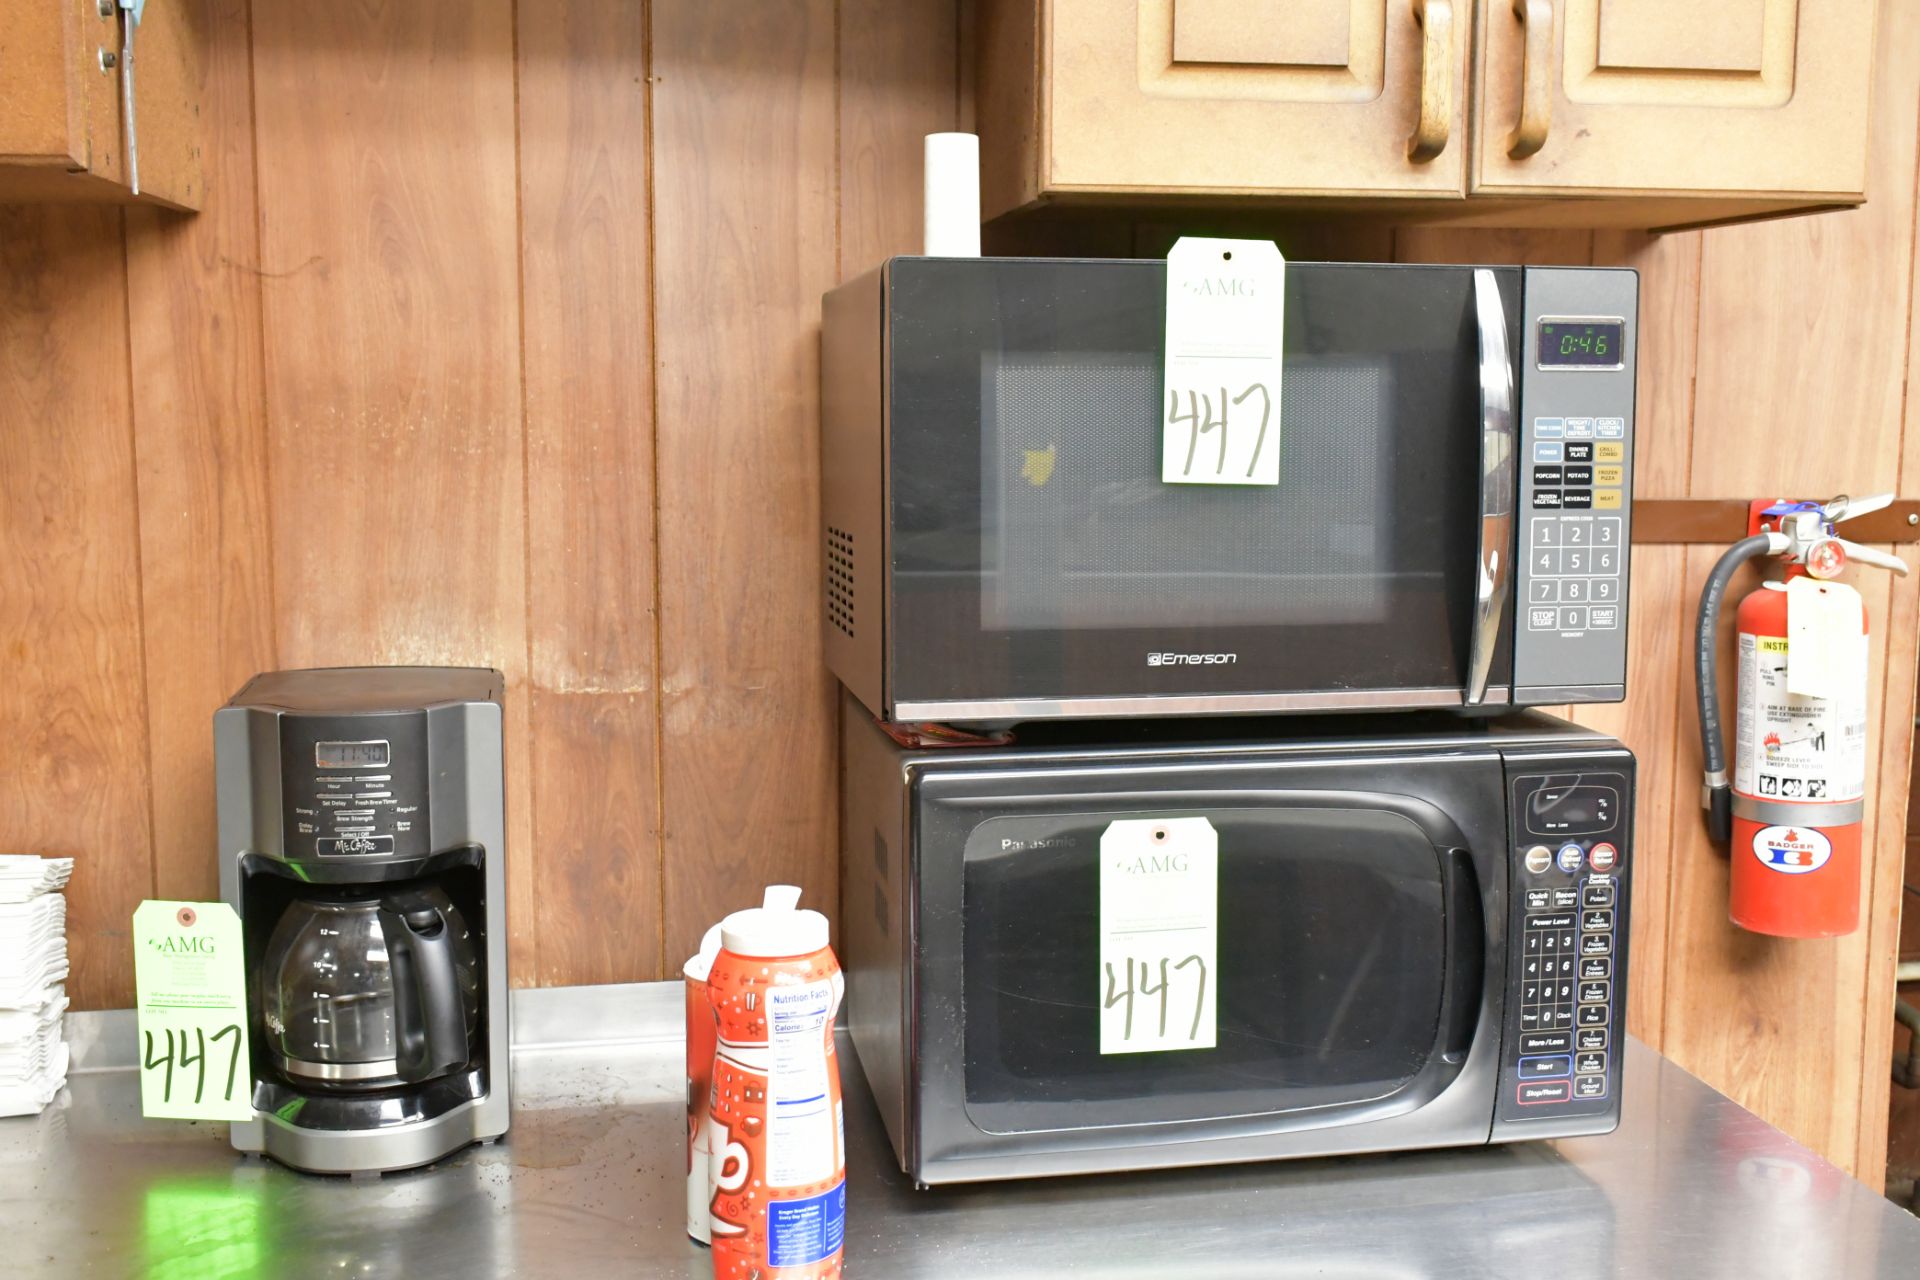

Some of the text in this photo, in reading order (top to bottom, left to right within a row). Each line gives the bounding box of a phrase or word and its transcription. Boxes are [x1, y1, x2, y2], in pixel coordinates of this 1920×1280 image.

[1198, 278, 1254, 296] AMG
[1560, 335, 1607, 354] 0:46
[1168, 383, 1270, 478] 447
[1542, 528, 1551, 542] 1
[1572, 527, 1580, 542] 2
[1602, 527, 1610, 542] 3
[1540, 554, 1550, 568] 4
[1571, 554, 1580, 568] 5
[1602, 554, 1610, 567] 6
[1541, 585, 1549, 598] 7
[1570, 584, 1579, 597] 8
[1600, 584, 1608, 597] 9
[1569, 612, 1577, 624] 0
[1764, 641, 1788, 651] INSTR
[1162, 653, 1236, 665] Emerson
[1768, 841, 1814, 849] BADGER
[1132, 853, 1188, 874] AMG
[163, 936, 214, 953] AMG
[1530, 938, 1536, 948] 1
[1546, 938, 1554, 947] 2
[1564, 937, 1571, 946] 3
[1528, 963, 1536, 972] 4
[1546, 962, 1553, 972] 5
[1562, 961, 1570, 970] 6
[774, 989, 828, 1004] Nutrition Facts
[1104, 954, 1206, 1040] 447
[1528, 988, 1536, 998] 7
[1544, 987, 1552, 997] 8
[1561, 986, 1569, 996] 9
[1543, 1012, 1551, 1022] 0
[145, 1024, 241, 1104] 447
[1526, 1089, 1562, 1097] Stop/Reset
